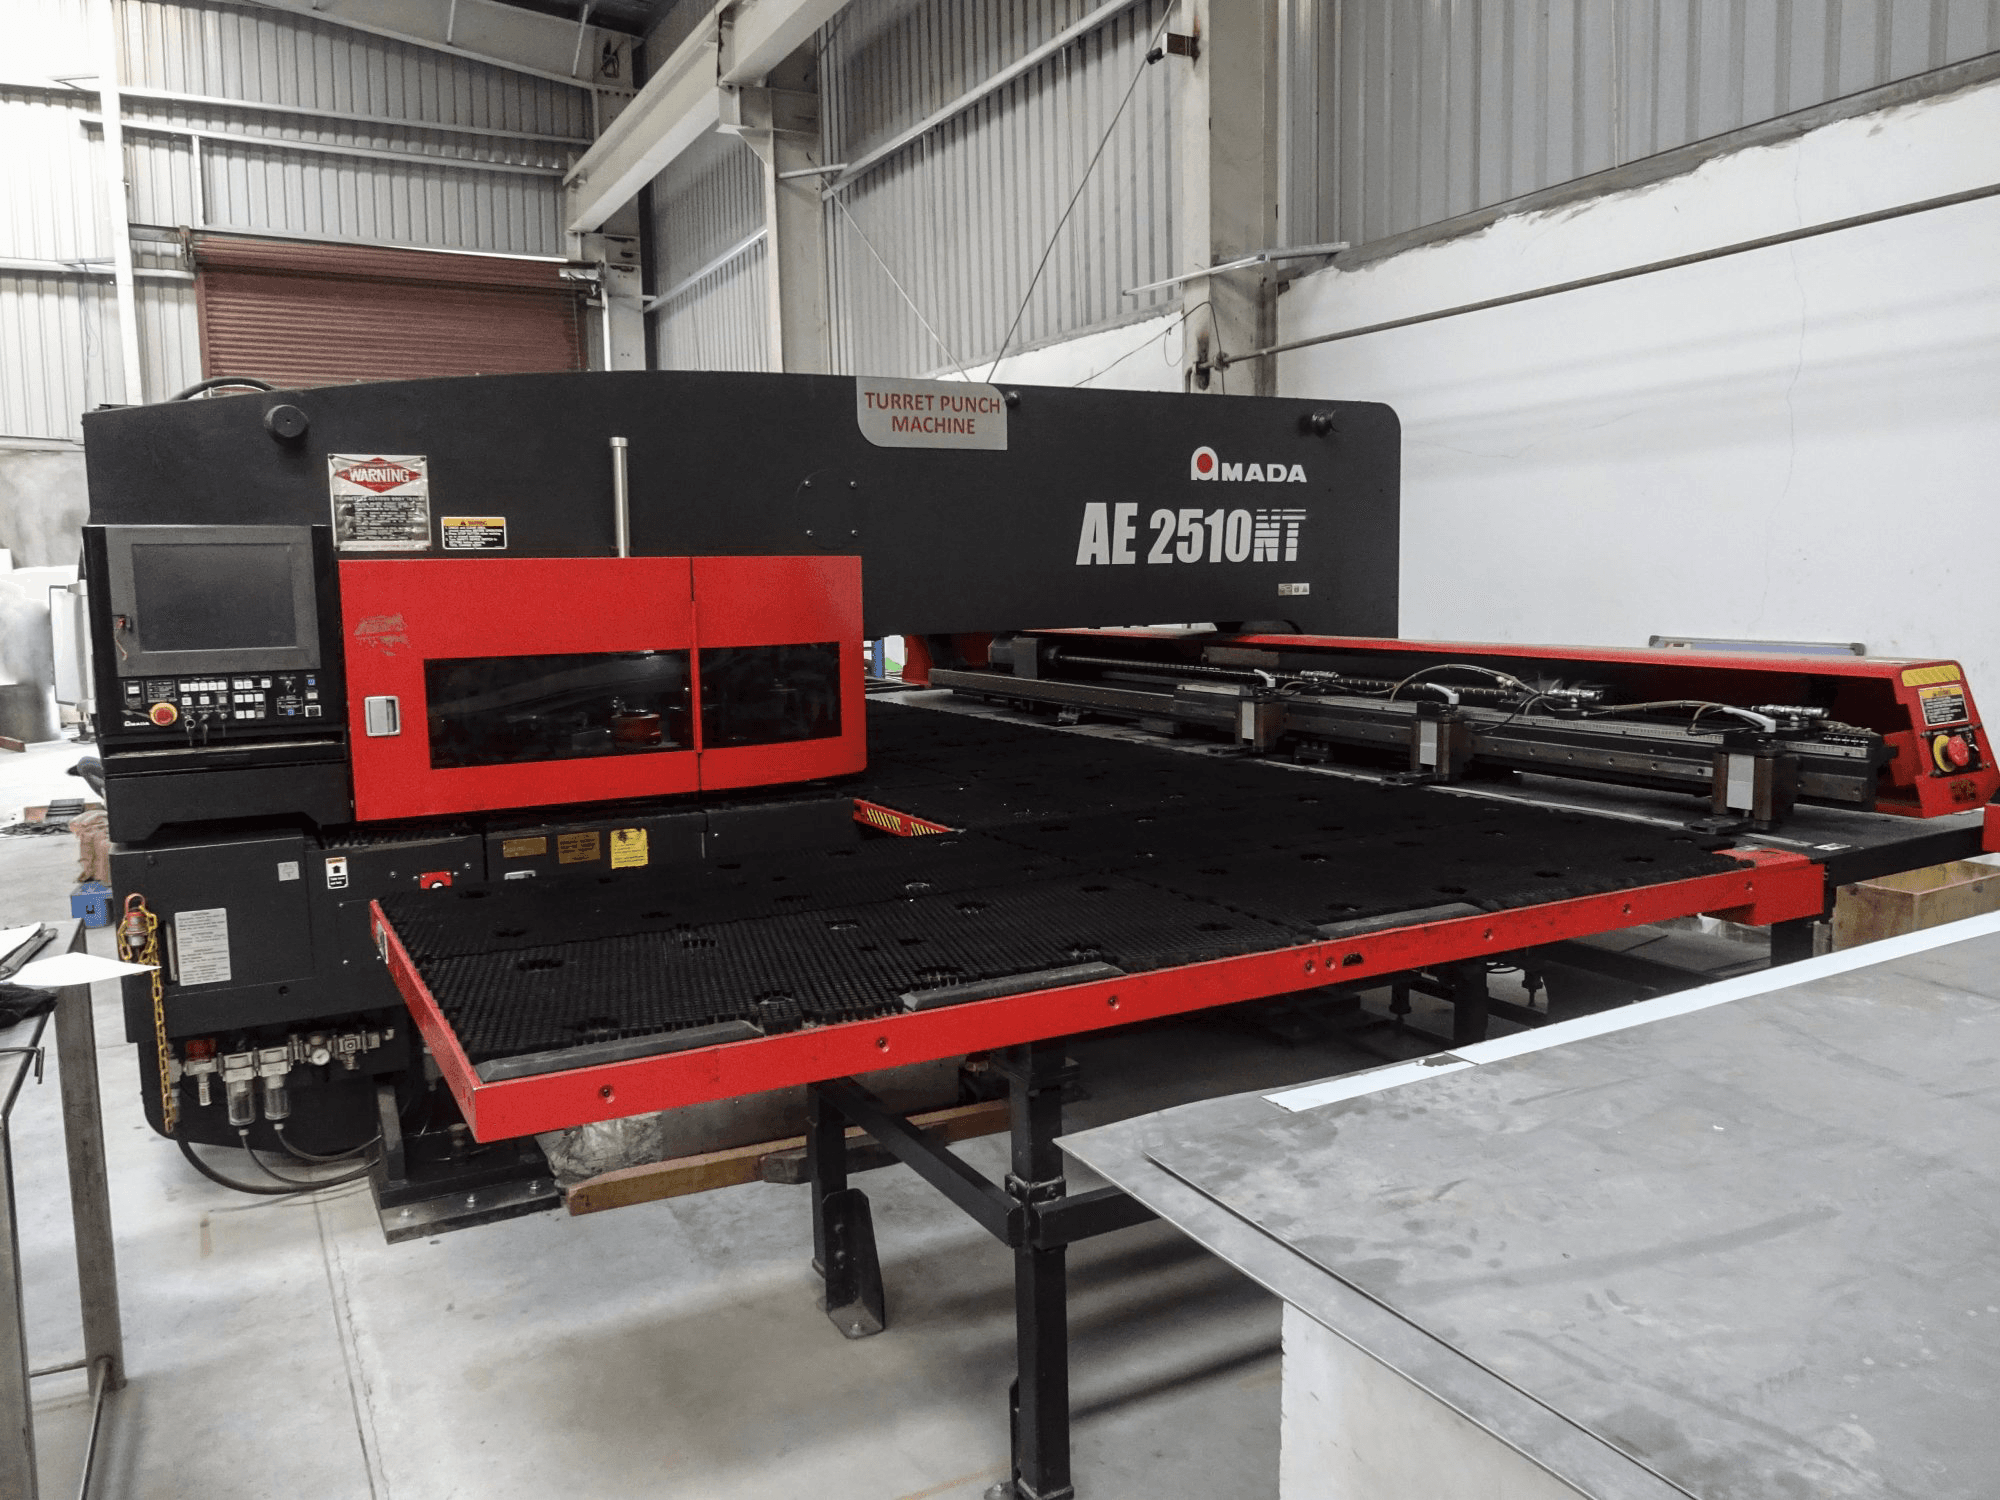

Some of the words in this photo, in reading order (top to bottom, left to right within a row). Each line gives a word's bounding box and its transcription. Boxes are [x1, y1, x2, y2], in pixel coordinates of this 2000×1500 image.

[864, 392, 935, 411] TURRET
[940, 395, 1001, 414] PUNCH
[891, 415, 976, 435] MACHINE
[349, 468, 410, 483] WARNING
[1190, 446, 1308, 483] AMADA
[1076, 502, 1139, 566] AE
